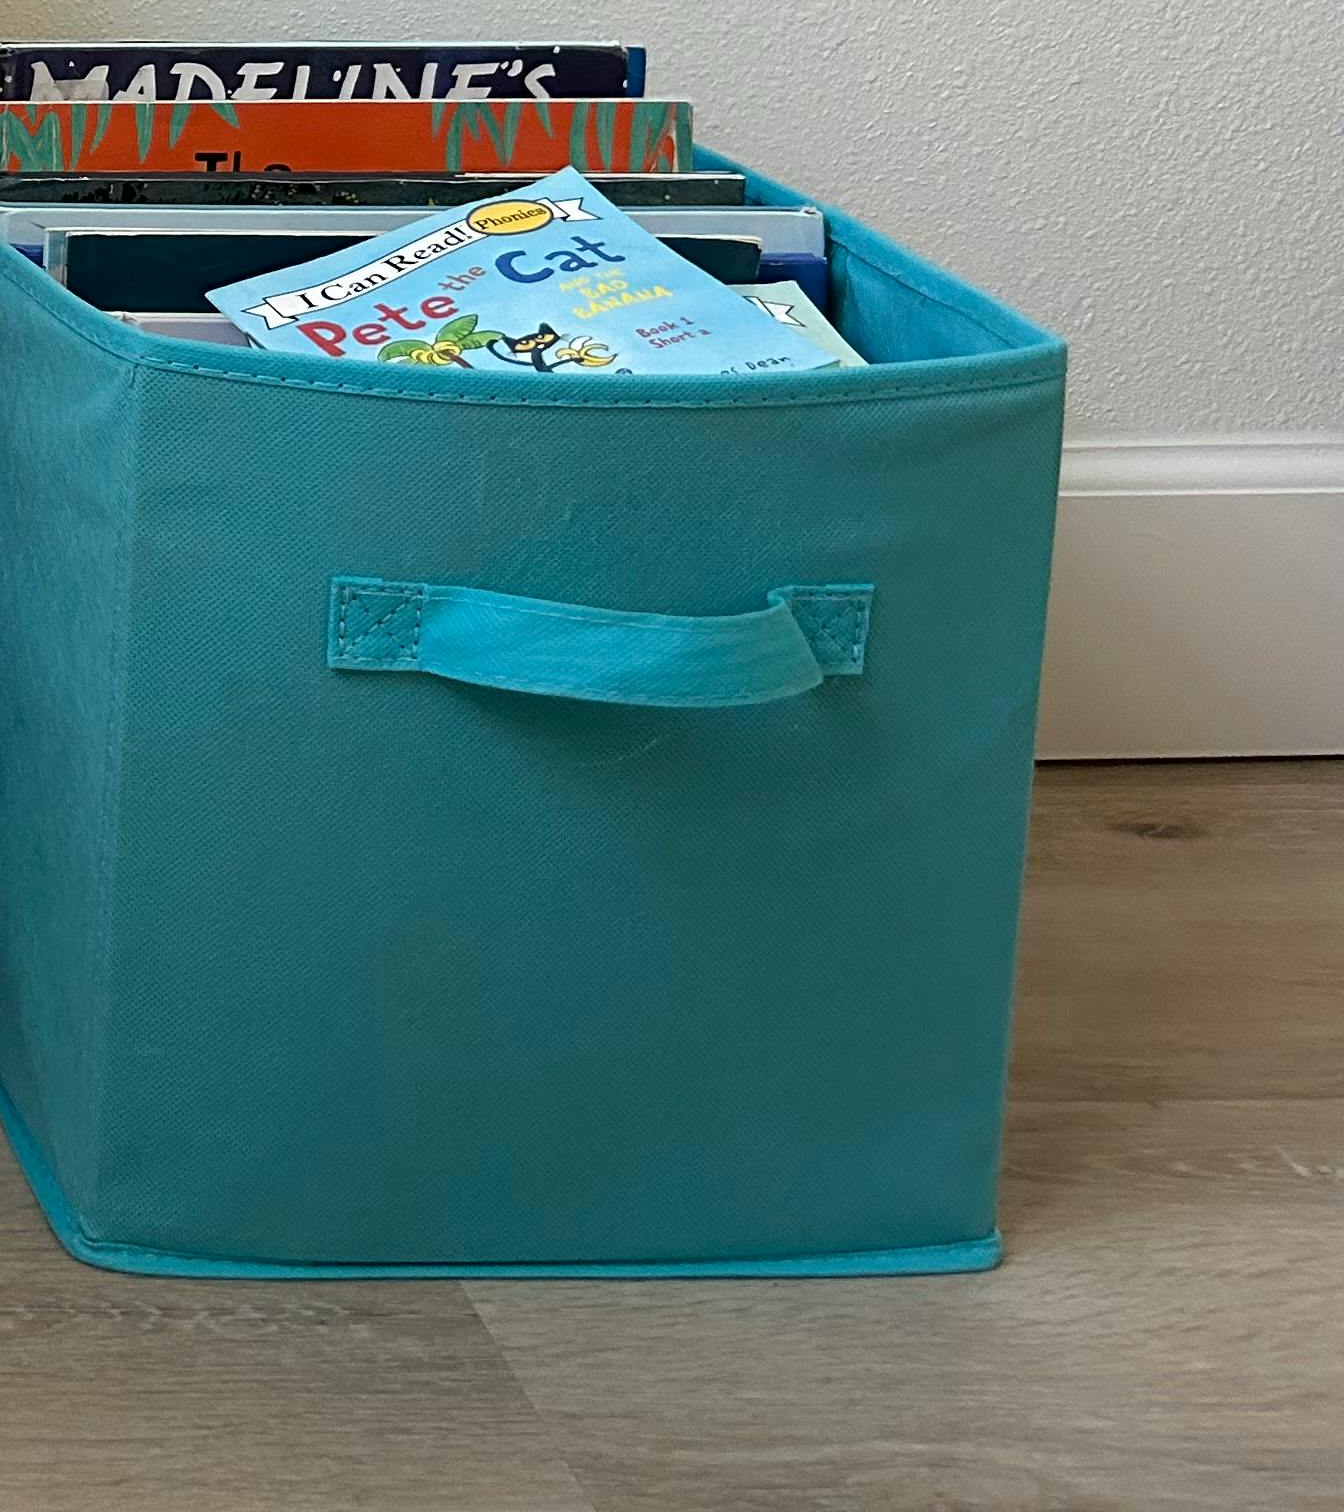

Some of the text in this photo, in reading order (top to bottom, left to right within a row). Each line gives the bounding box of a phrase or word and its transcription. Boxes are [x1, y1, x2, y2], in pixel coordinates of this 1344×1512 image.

[297, 205, 547, 309] I Can Read! Phonics
[297, 236, 626, 358] Pete the Cat
[636, 321, 679, 338] Book
[649, 330, 696, 348] Short
[746, 357, 790, 370] Dean
